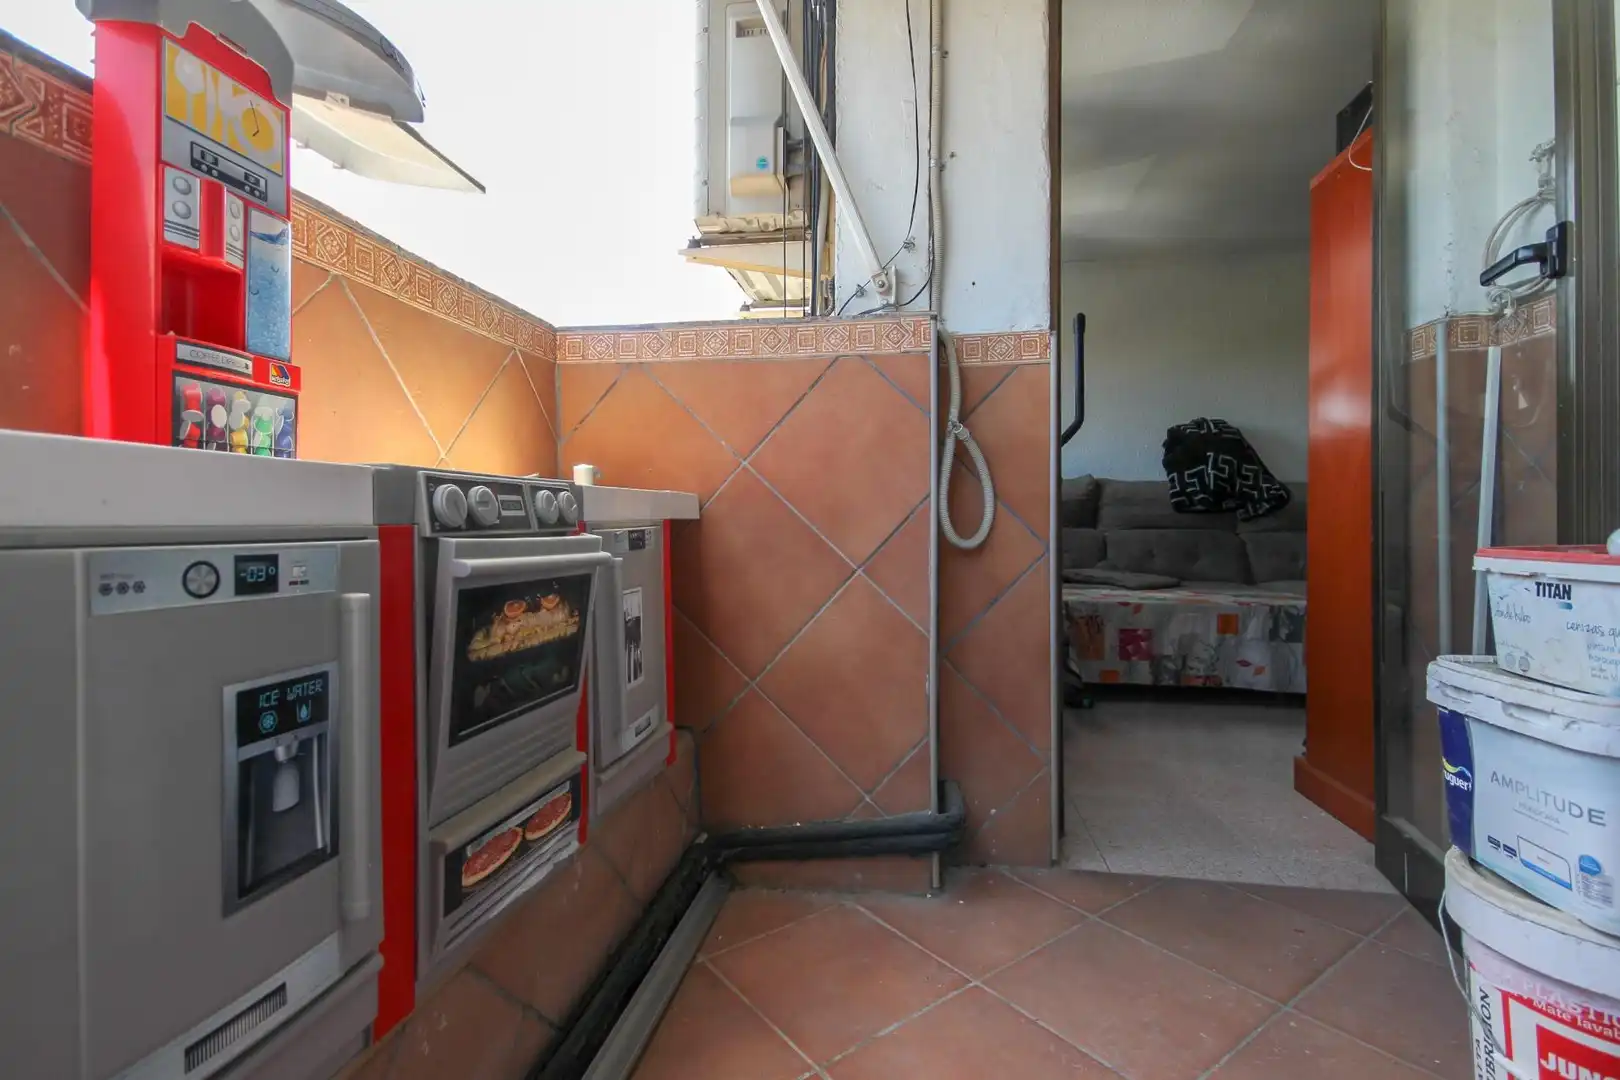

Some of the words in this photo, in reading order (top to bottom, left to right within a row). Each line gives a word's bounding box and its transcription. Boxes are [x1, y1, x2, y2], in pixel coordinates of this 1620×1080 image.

[1535, 581, 1572, 601] TITAN
[259, 688, 279, 709] ICE
[286, 678, 323, 701] WATER
[1490, 770, 1607, 827] AMPLITUDE
[1532, 998, 1572, 1023] Mate
